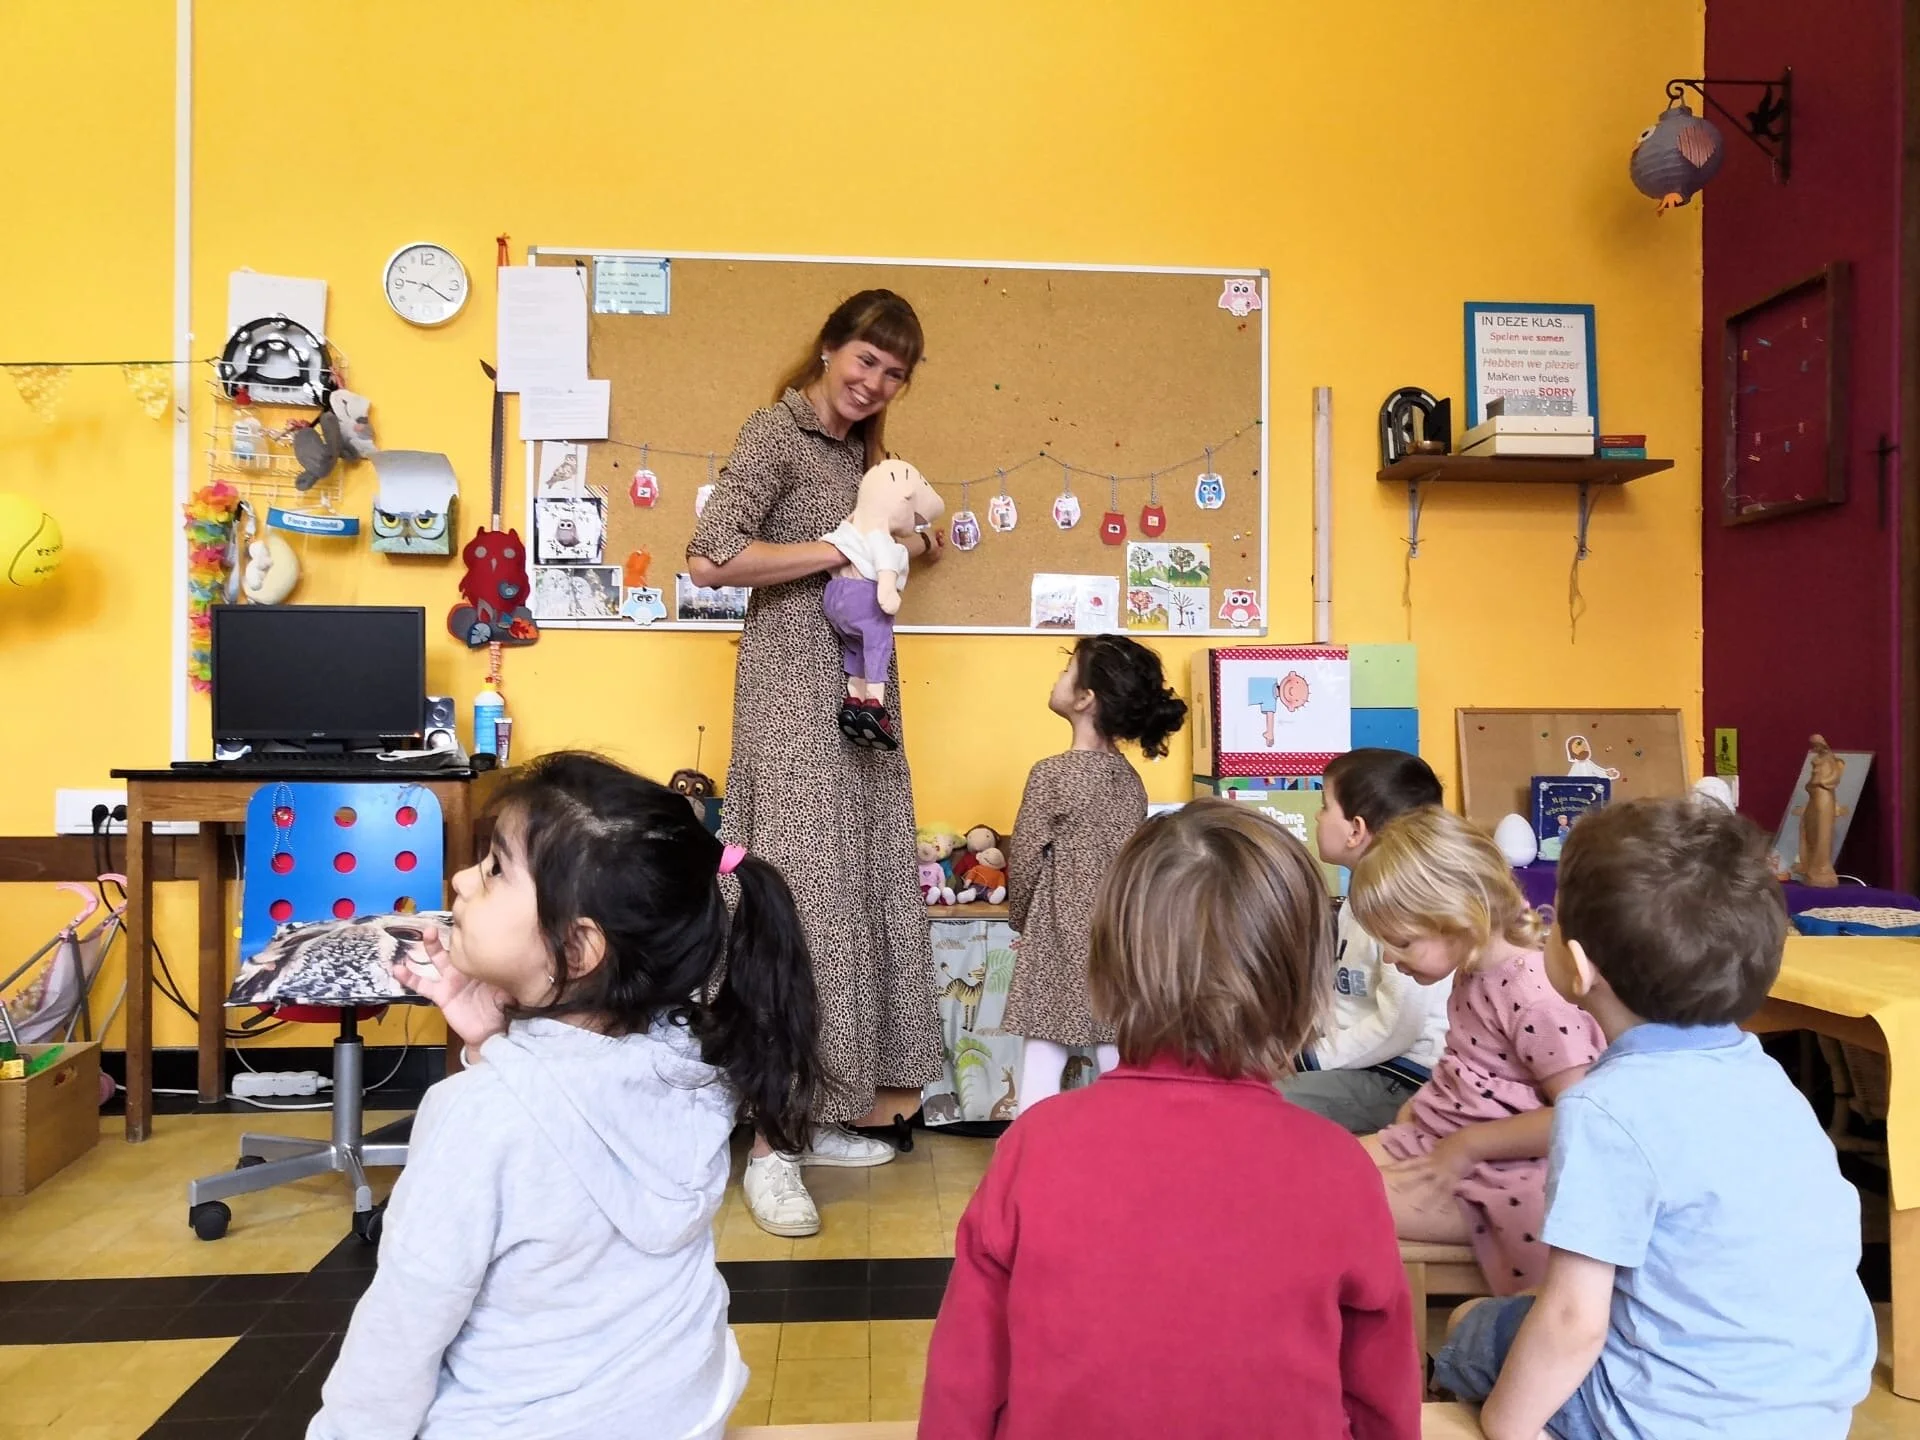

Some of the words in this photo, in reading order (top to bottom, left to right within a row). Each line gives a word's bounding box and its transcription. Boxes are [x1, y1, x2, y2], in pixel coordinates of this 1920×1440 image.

[420, 252, 435, 266] 12
[394, 278, 405, 290] 9
[448, 279, 460, 291] 3
[1482, 316, 1494, 326] IN
[1497, 316, 1529, 328] DEZE
[1490, 332, 1520, 343] Spelen
[1536, 334, 1565, 343] samen
[1483, 358, 1524, 369] Hebben
[1527, 361, 1542, 369] we
[1545, 360, 1581, 372] plezier
[1522, 375, 1537, 383] we
[1539, 373, 1570, 385] foutjes
[1521, 388, 1536, 396] we
[1538, 386, 1577, 398] SORRY
